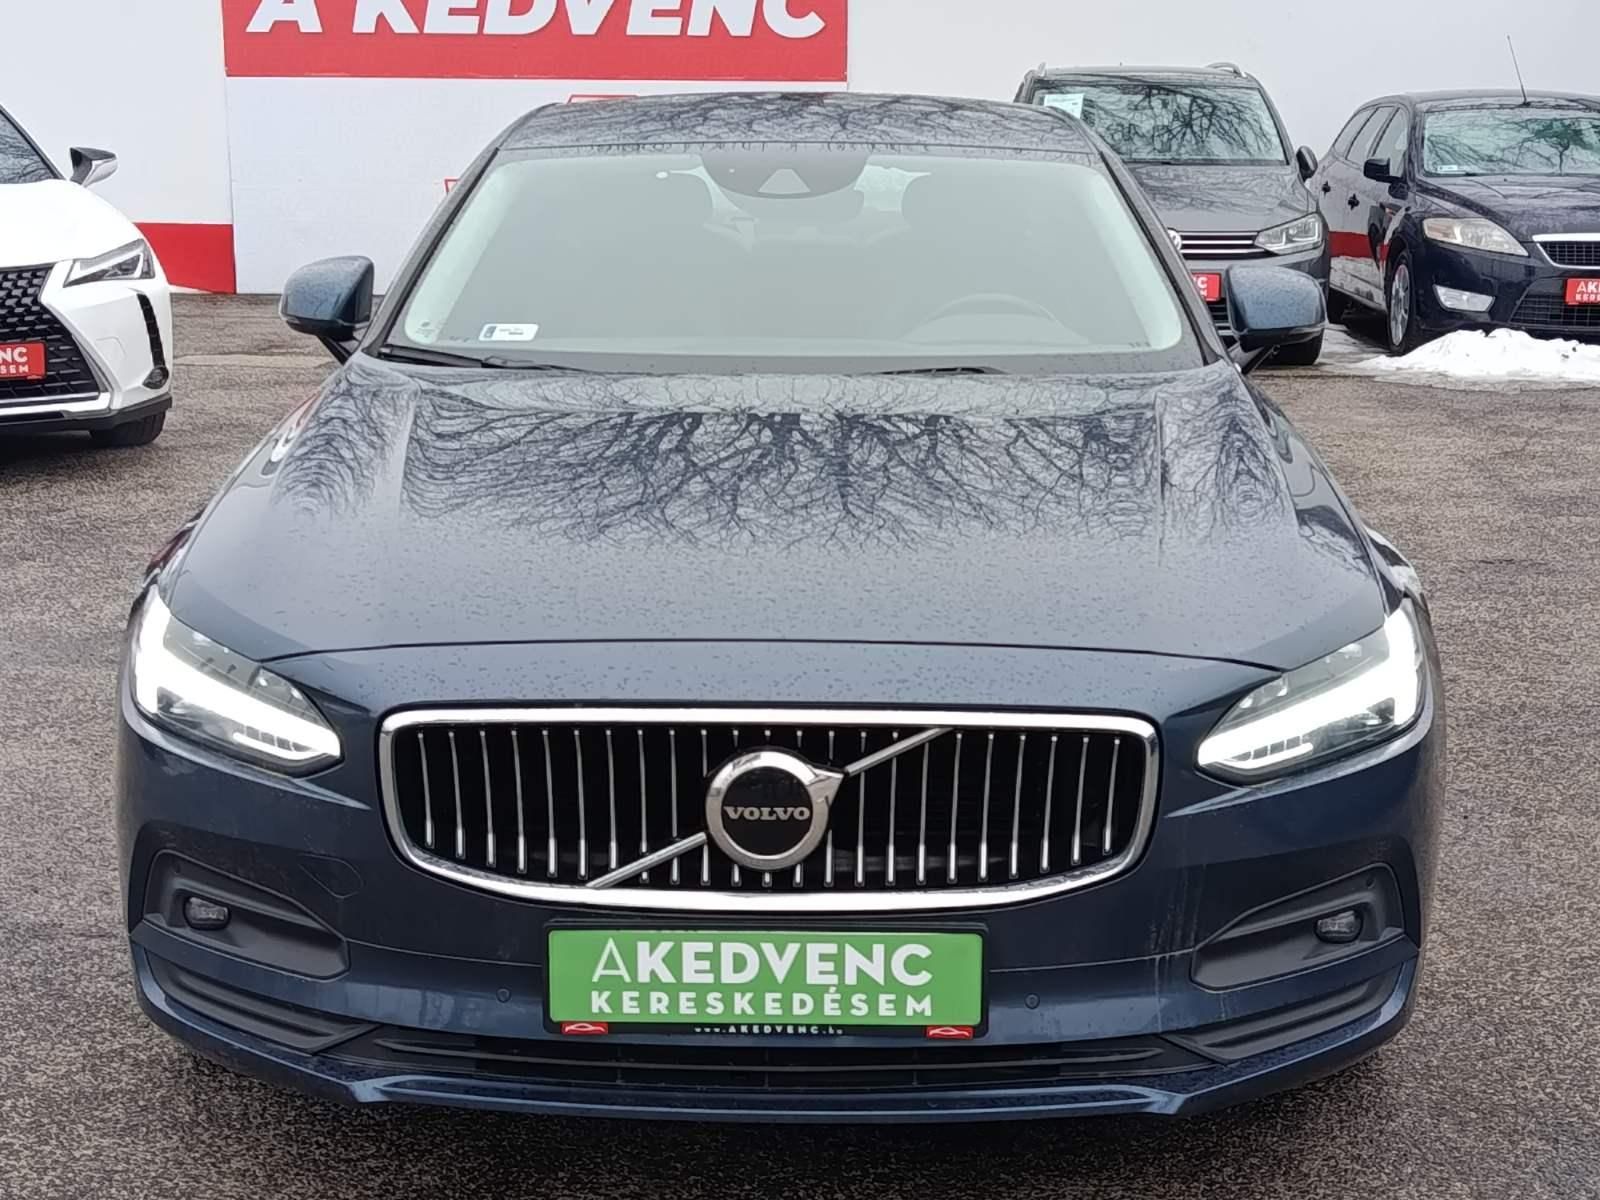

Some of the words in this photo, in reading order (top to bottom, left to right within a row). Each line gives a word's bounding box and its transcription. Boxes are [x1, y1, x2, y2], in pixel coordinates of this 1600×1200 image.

[245, 0, 323, 33] A
[352, 0, 826, 38] KEDVENC
[723, 806, 810, 821] VOLVO
[591, 937, 933, 987] AKEDVENC
[591, 986, 933, 1017] KERESKEDÉSEM
